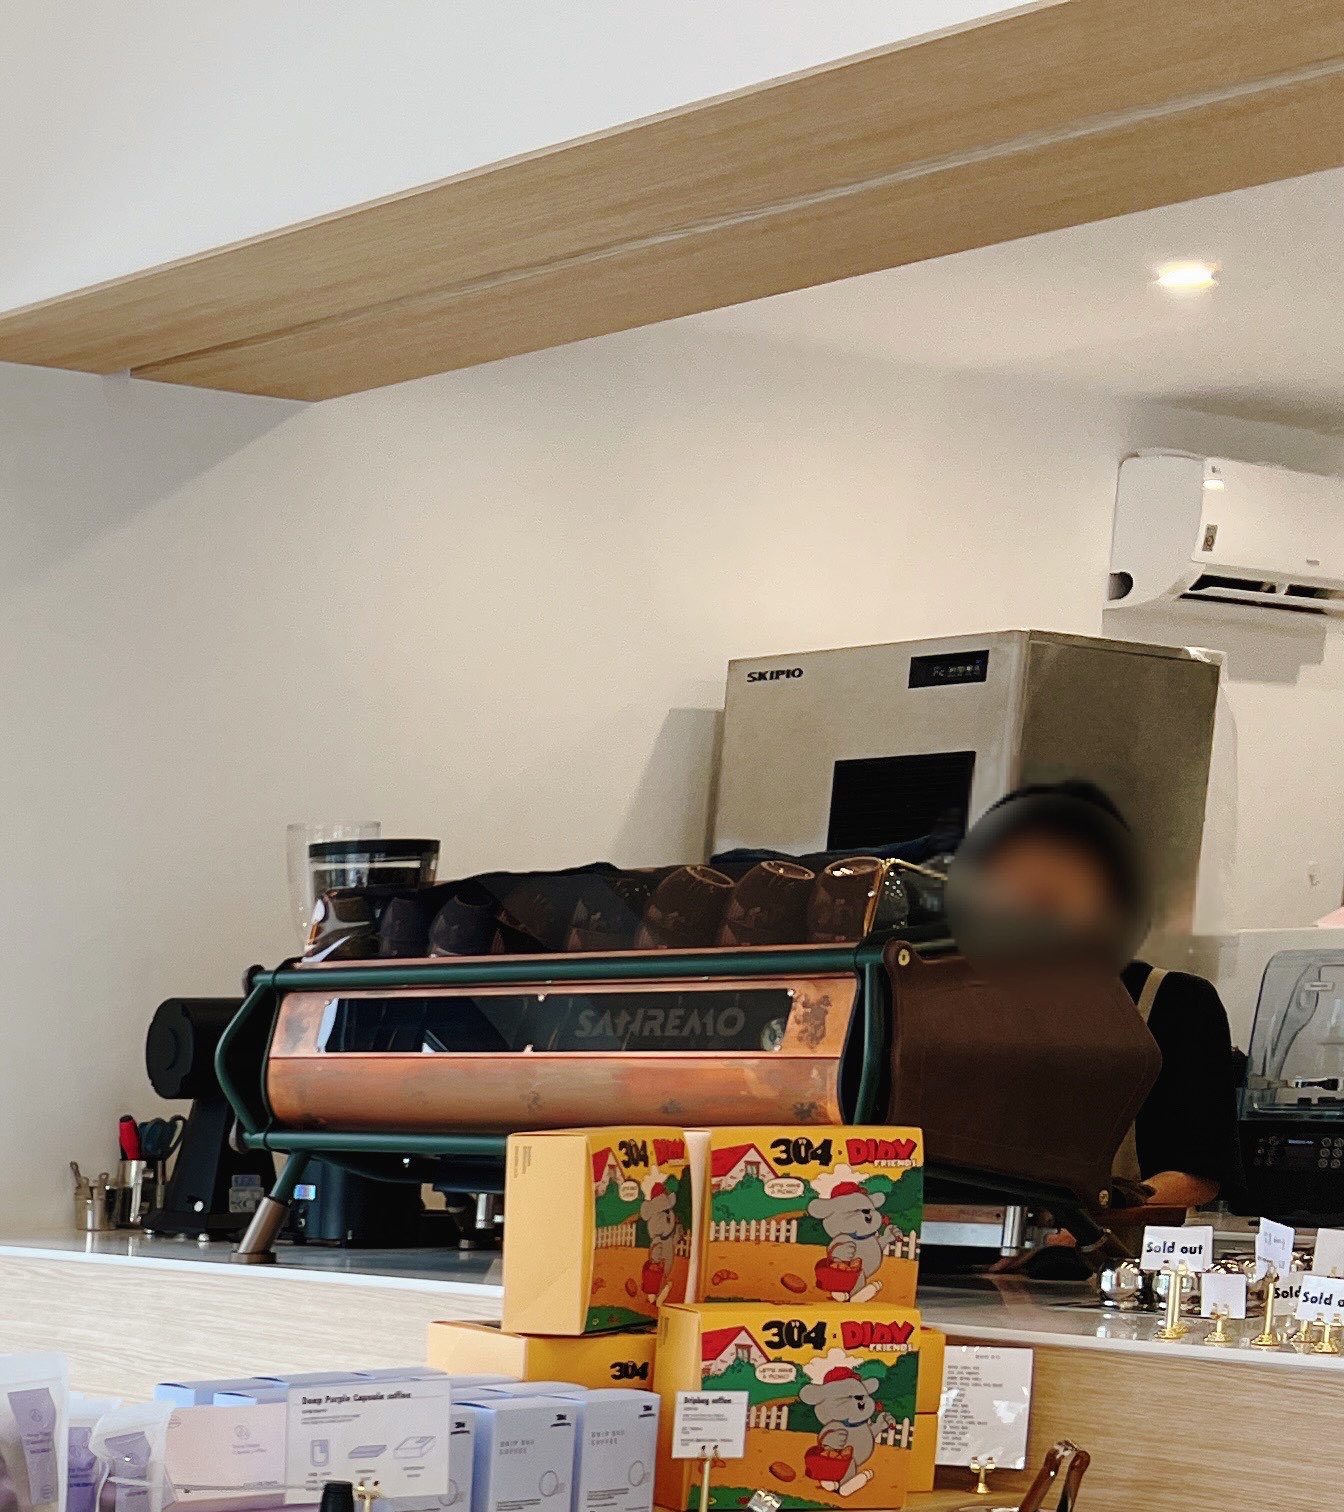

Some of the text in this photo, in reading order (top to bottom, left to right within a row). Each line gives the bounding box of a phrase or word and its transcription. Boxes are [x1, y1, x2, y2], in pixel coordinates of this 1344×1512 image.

[747, 668, 804, 682] SKIPIO
[574, 1006, 746, 1038] SANREMO
[770, 1136, 833, 1166] 304
[1146, 1241, 1203, 1255] Sold out
[1303, 1291, 1332, 1306] Sold
[762, 1319, 828, 1351] 304
[610, 1360, 650, 1381] 304
